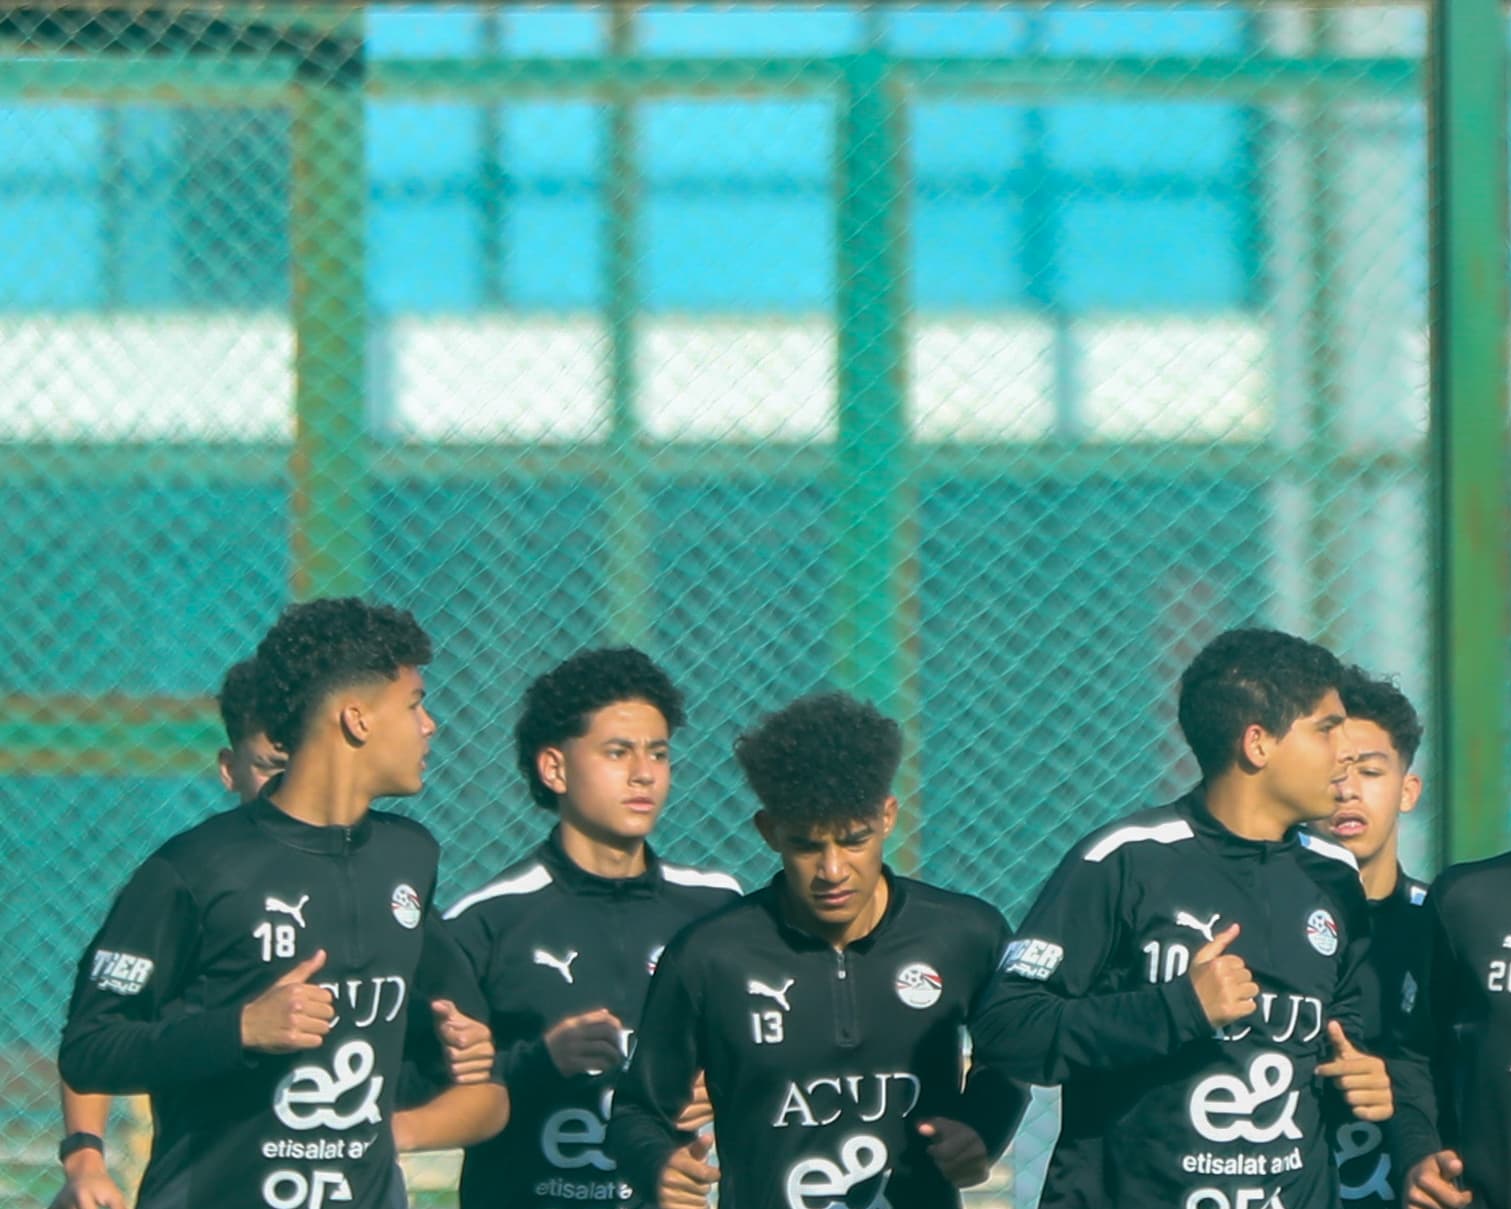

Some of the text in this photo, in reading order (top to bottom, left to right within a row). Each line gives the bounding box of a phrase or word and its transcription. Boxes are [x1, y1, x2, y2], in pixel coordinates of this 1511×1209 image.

[253, 922, 296, 962] 18
[752, 1012, 784, 1045] 13
[772, 1072, 921, 1127] ACUD
[262, 1138, 344, 1160] etisalat
[1182, 1152, 1267, 1176] etisalat
[535, 1178, 615, 1200] etisalat
